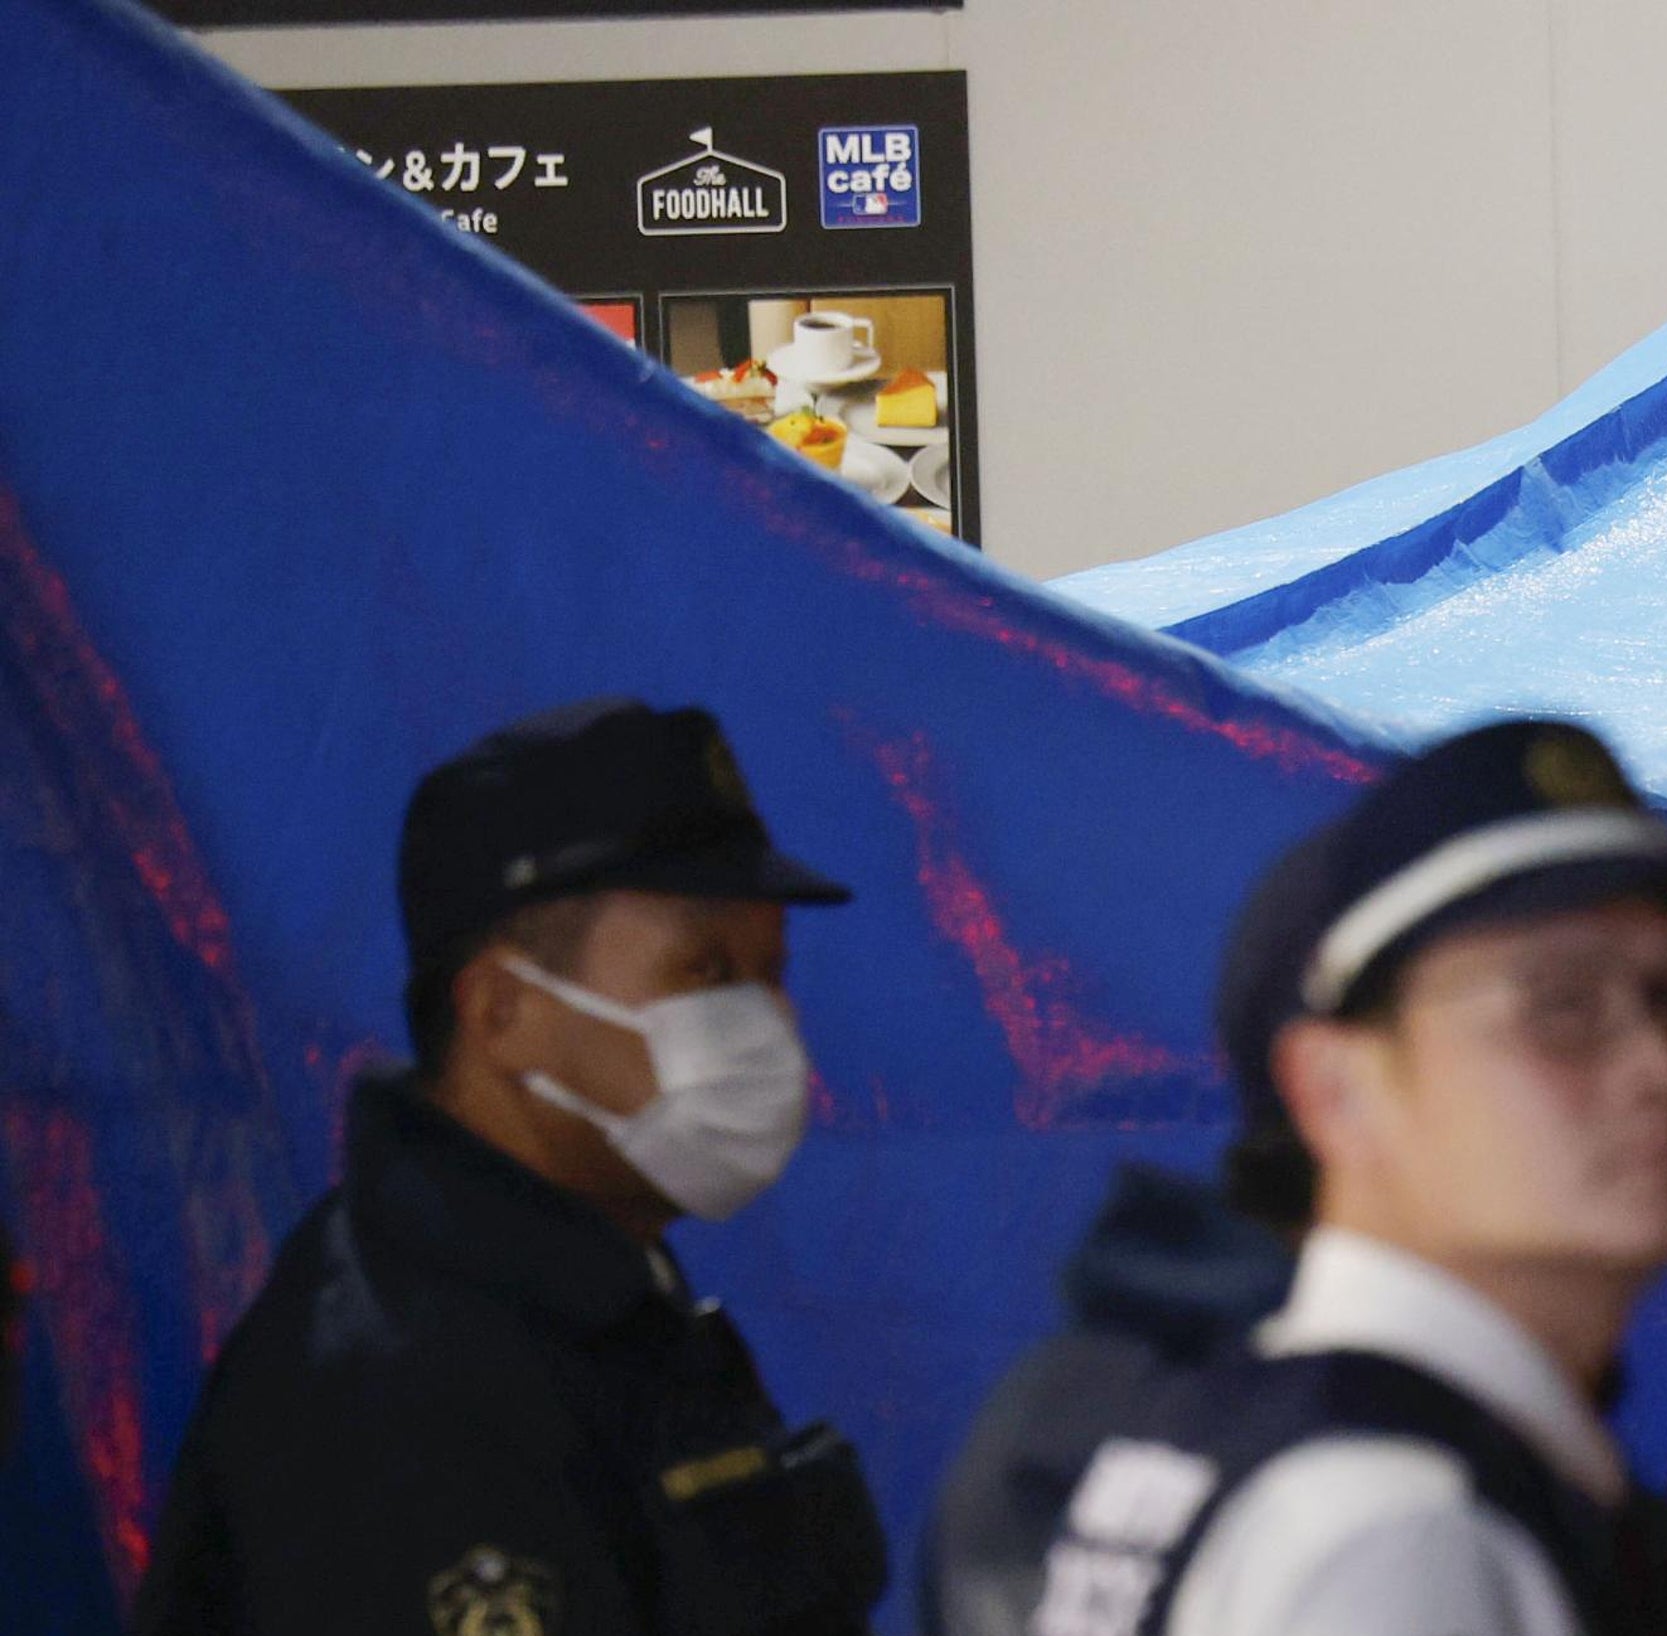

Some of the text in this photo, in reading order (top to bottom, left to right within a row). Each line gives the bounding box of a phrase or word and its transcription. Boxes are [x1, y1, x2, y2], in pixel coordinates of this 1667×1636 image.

[826, 133, 912, 164] MLB
[337, 142, 569, 192] ン&カフェ
[693, 165, 727, 187] The
[827, 162, 913, 193] café
[652, 187, 770, 221] FOODHALL
